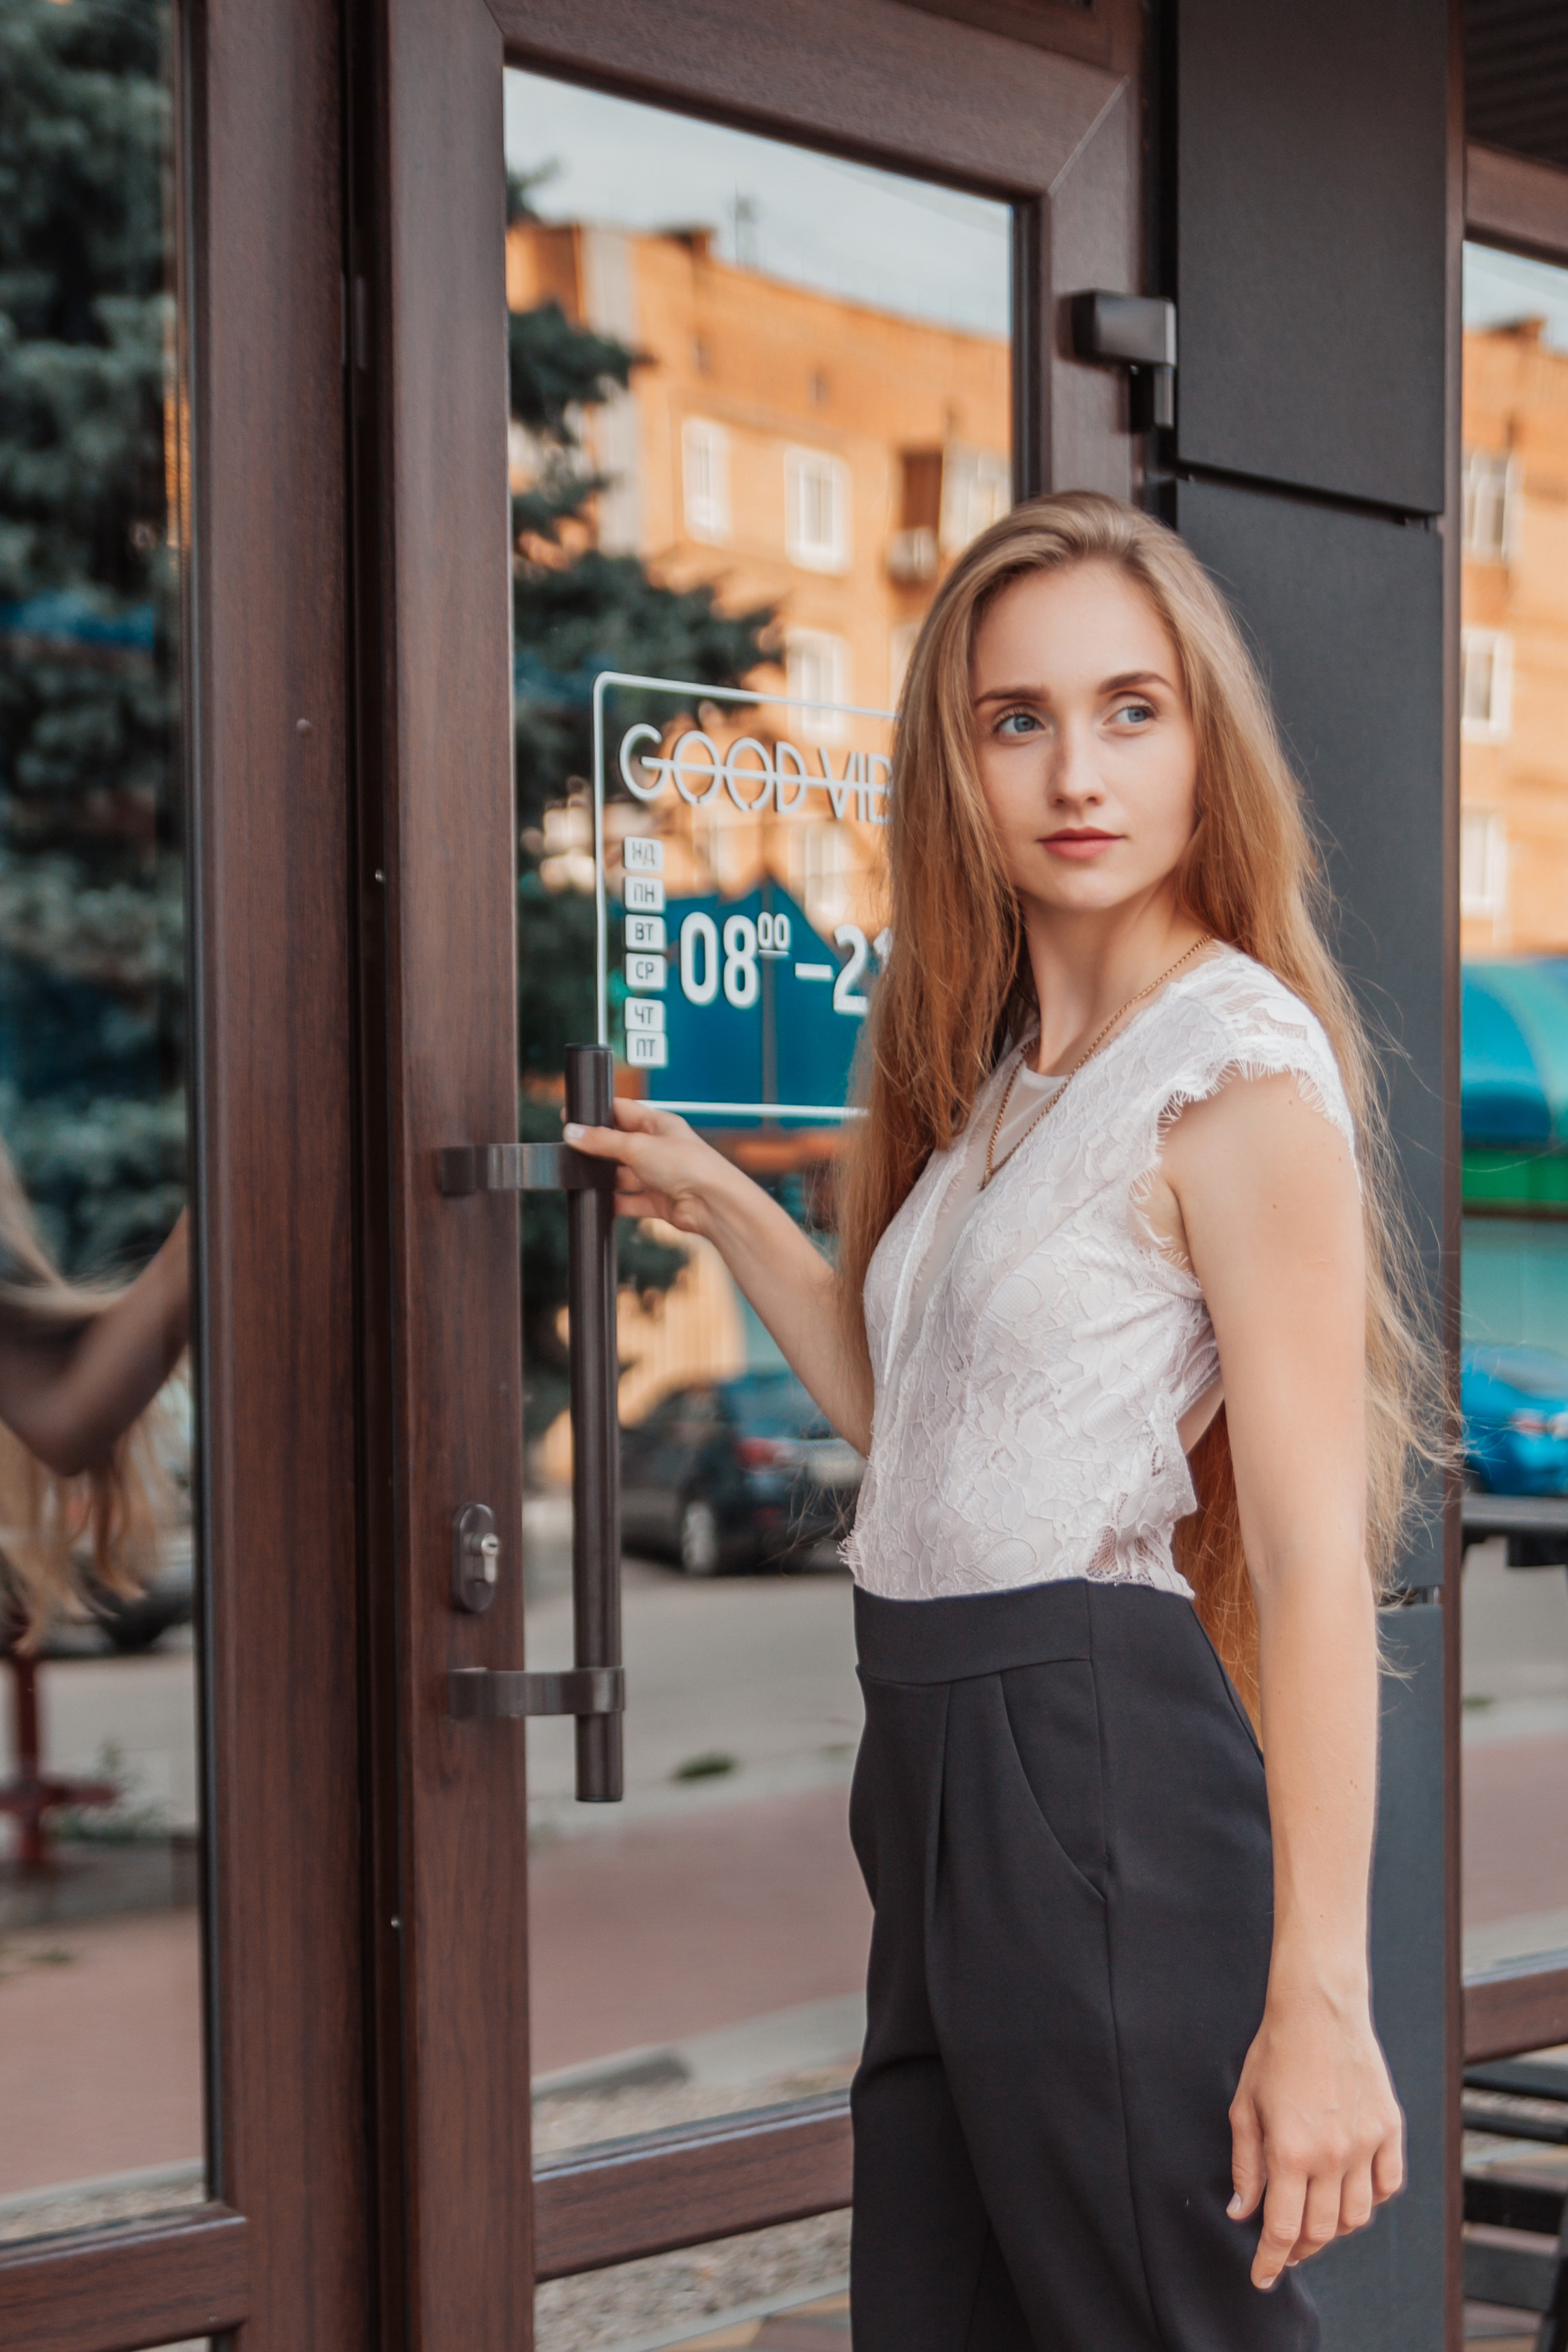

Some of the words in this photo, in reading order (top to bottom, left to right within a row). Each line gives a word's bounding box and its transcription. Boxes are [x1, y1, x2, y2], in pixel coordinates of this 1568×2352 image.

[620, 723, 807, 813] GOOD
[632, 841, 655, 865] НД
[633, 883, 655, 903] ПН
[635, 922, 654, 941] ВТ
[635, 961, 654, 980] СР
[635, 1004, 654, 1025] ЧТ
[636, 1038, 656, 1057] ПТ
